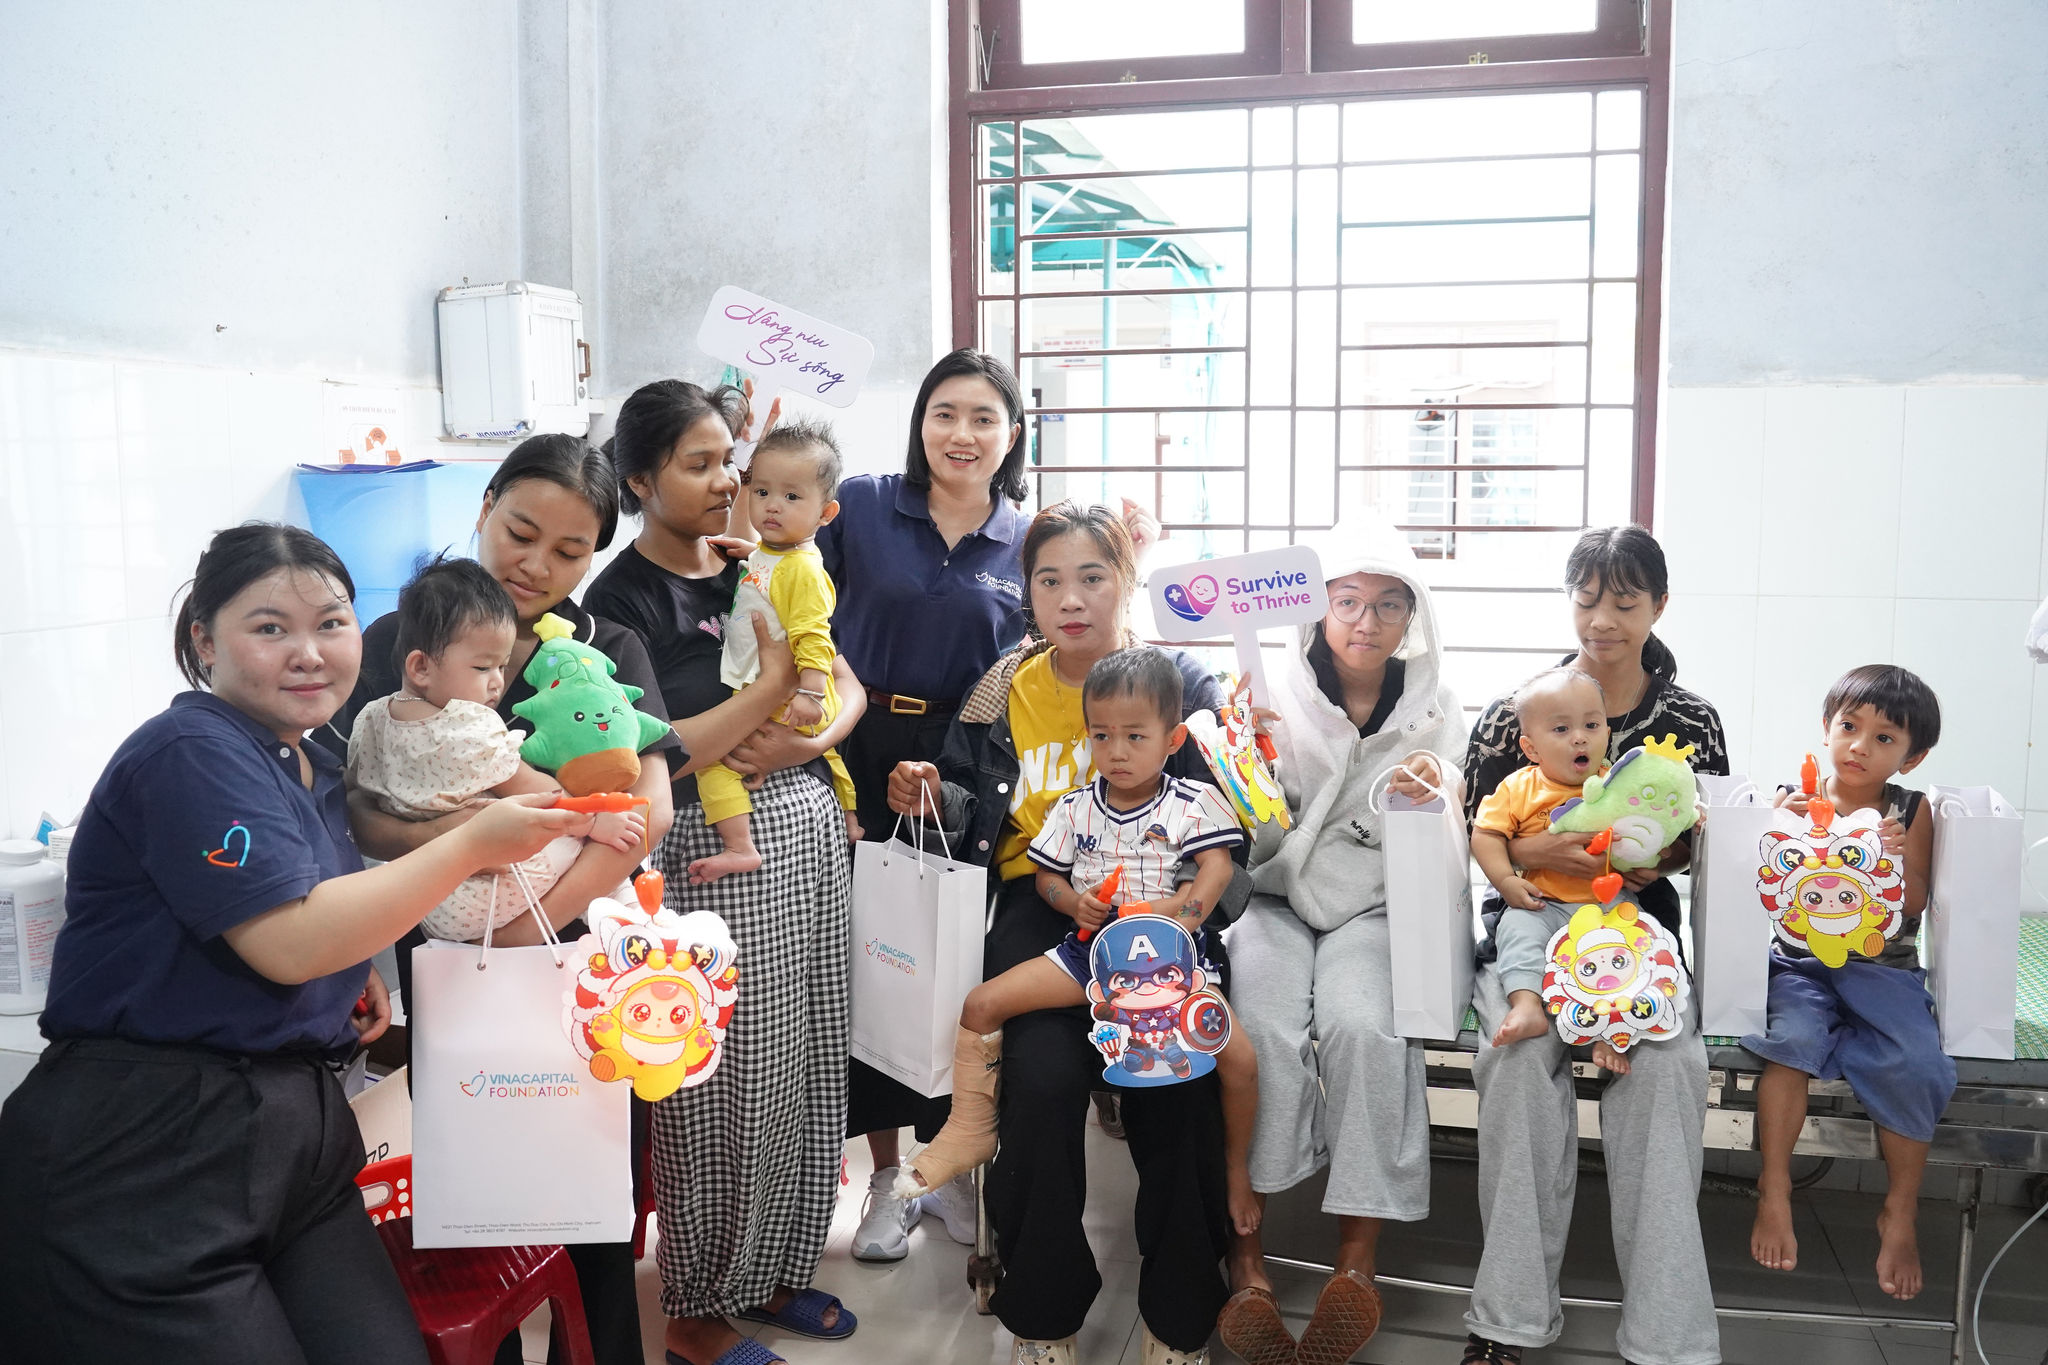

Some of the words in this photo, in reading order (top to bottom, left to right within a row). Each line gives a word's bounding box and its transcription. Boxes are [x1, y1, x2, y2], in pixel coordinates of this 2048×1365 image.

[725, 304, 793, 344] Nâng
[795, 331, 830, 348] niu
[798, 361, 846, 394] sống
[1226, 570, 1307, 596] Survive
[1230, 601, 1250, 614] to
[1252, 591, 1311, 611] Thrive
[879, 942, 917, 967] VINACAPITAL
[1127, 934, 1160, 961] A
[877, 951, 917, 977] FOUNDATION
[489, 1073, 579, 1085] VINACAPITAL
[489, 1086, 580, 1098] FOUNDATION
